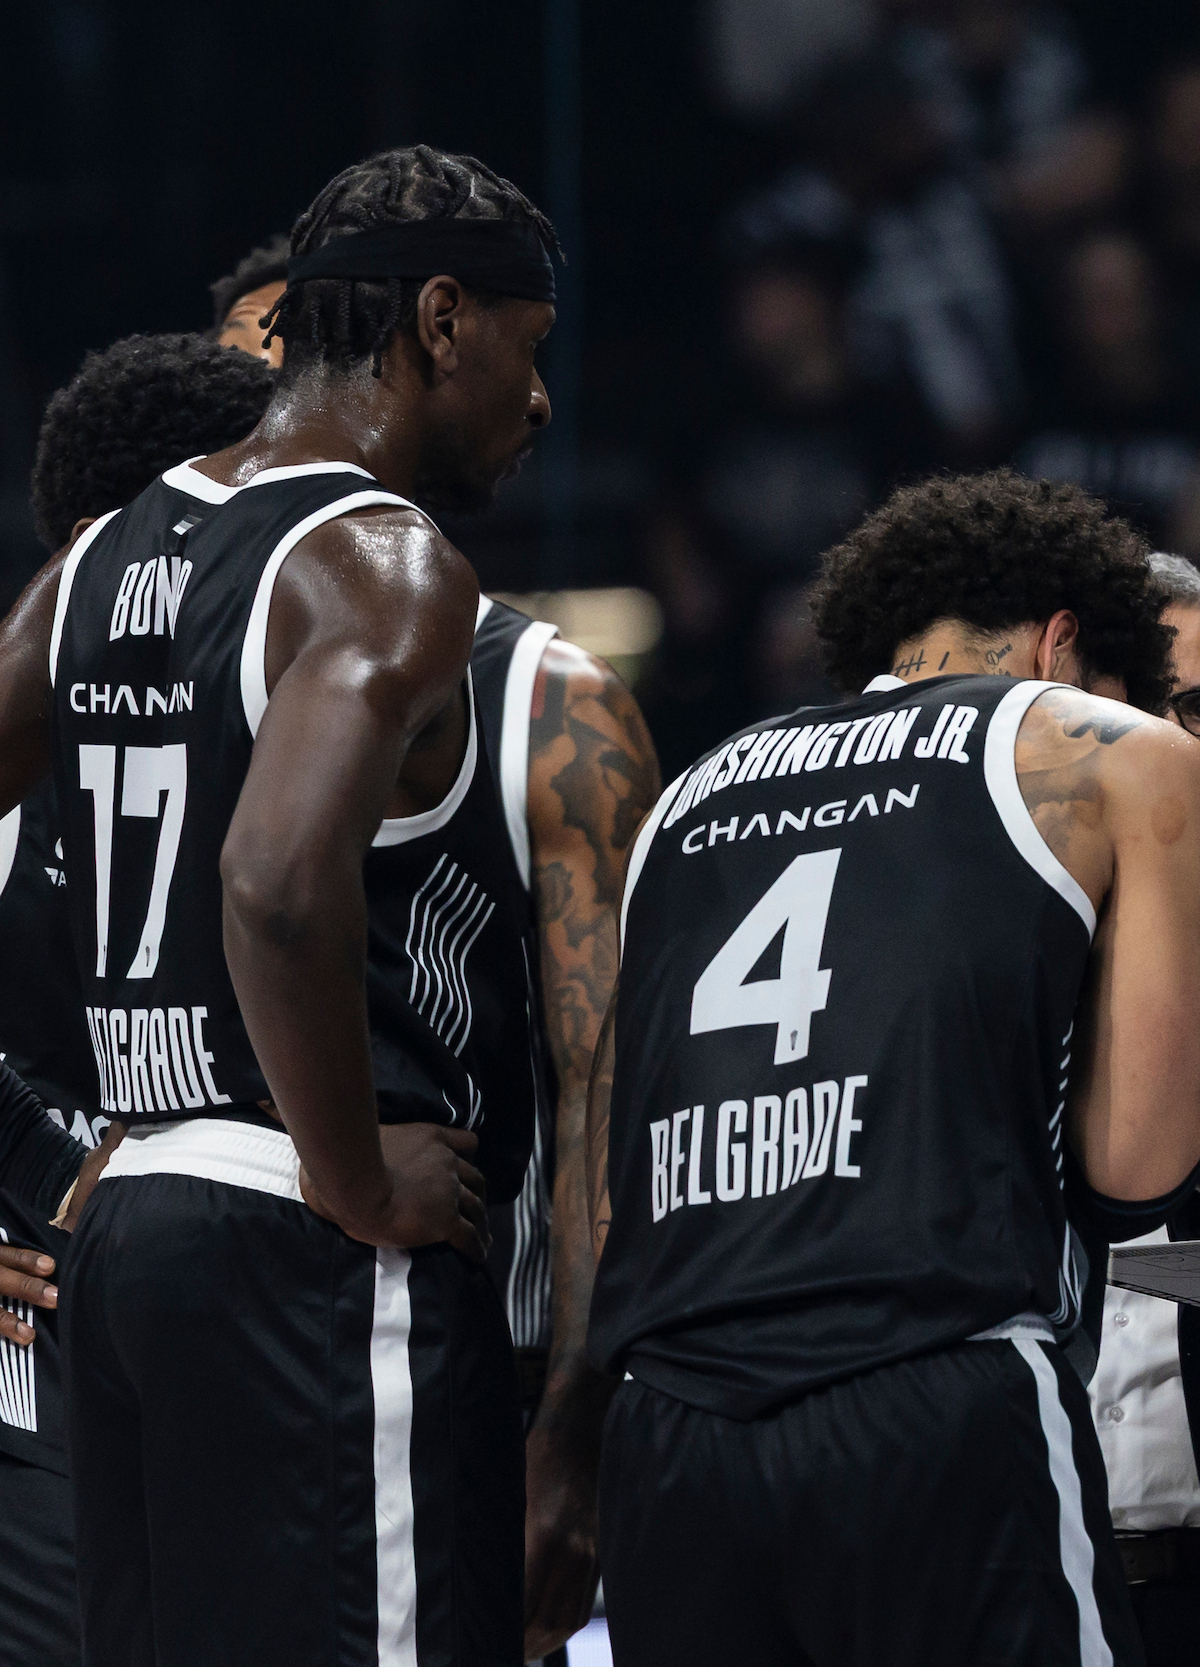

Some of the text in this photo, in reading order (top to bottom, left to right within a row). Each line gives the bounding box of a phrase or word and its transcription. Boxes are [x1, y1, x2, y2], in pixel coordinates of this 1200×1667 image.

[69, 681, 194, 716] CHANAN
[662, 703, 979, 830] WASHINGTON JR
[79, 743, 187, 979] 17
[681, 784, 920, 855] CHANGAN
[690, 847, 842, 1066] 4
[650, 1075, 868, 1223] BELGRADE
